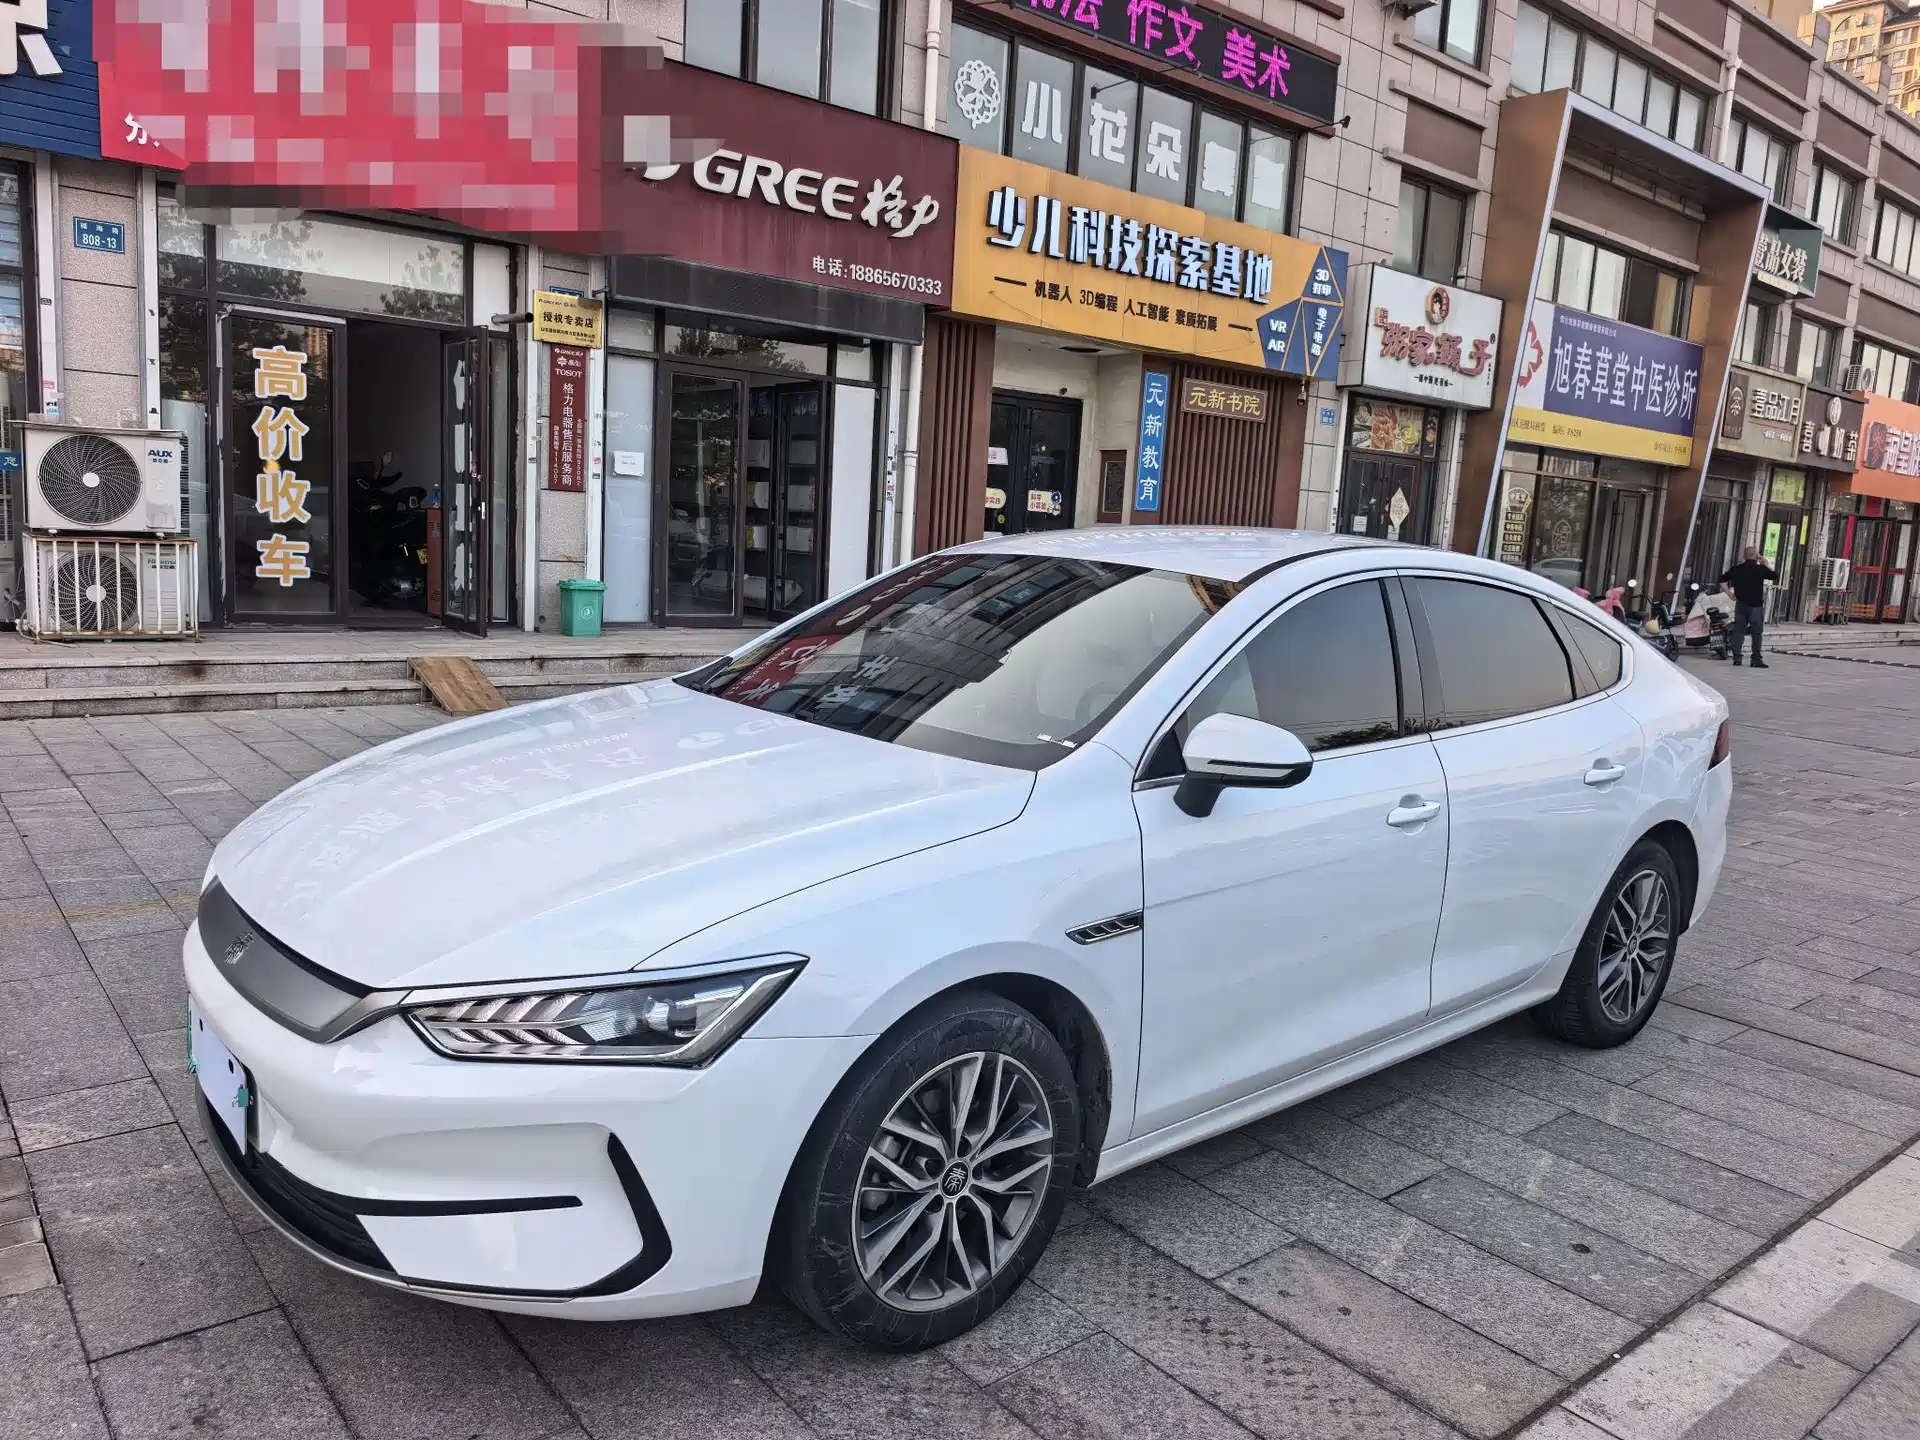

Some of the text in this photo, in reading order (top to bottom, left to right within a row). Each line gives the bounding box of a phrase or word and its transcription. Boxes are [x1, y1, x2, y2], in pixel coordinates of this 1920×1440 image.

[1127, 0, 1204, 61] 作文
[1222, 27, 1291, 98] 美术
[693, 148, 860, 220] GREE
[82, 233, 117, 249] 808-13
[985, 186, 1273, 305] 少儿科技探索基地
[1312, 282, 1332, 297] 打印
[1315, 268, 1330, 282] 3D
[543, 311, 594, 329] 授权专卖店
[1034, 279, 1218, 332] 机器人 3D编程 人工智能 素质拓展
[1267, 338, 1285, 353] AR
[1268, 318, 1287, 334] VR
[1310, 307, 1328, 357] 电子电路
[554, 368, 583, 378] TOSOT
[1549, 335, 1698, 420] 旭春草堂中医诊所
[1188, 386, 1261, 416] 元新书院
[148, 449, 173, 458] AUX
[562, 382, 575, 486] 格力电器售后服务商
[1139, 382, 1165, 502] 元新教育
[252, 345, 312, 587] 高价收车
